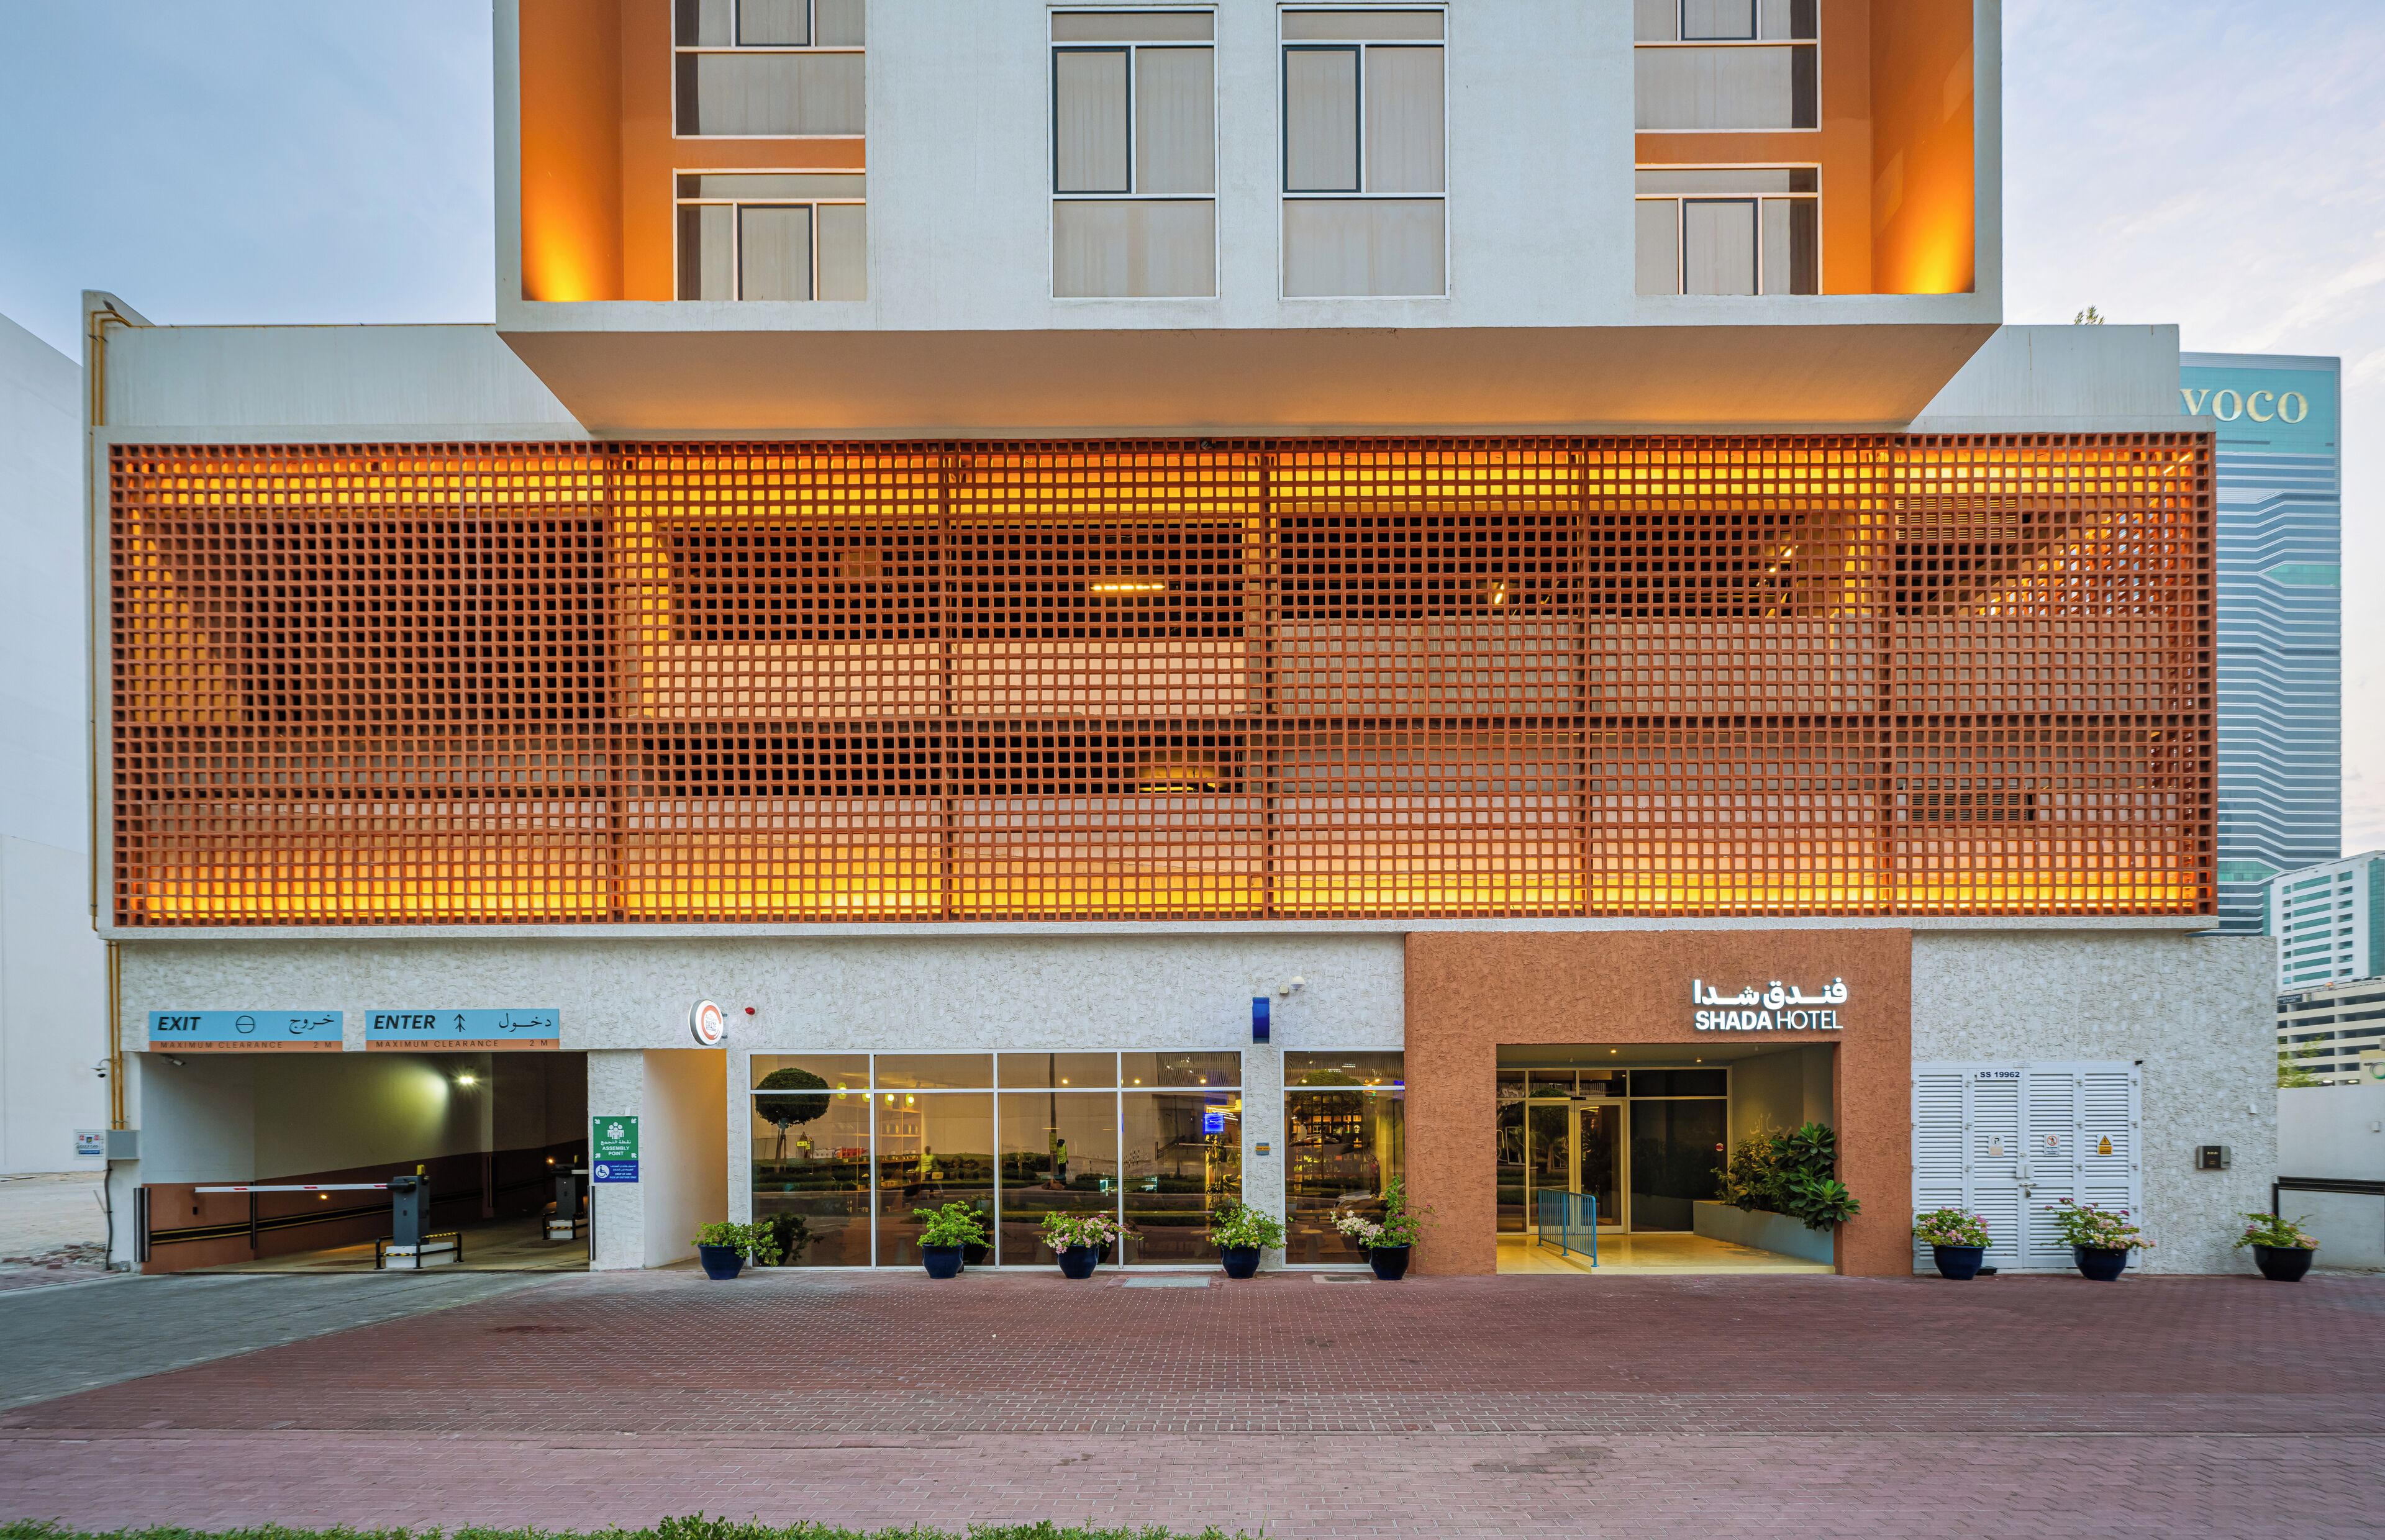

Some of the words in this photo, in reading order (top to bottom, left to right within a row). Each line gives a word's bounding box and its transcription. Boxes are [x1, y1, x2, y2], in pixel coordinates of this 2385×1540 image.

[1692, 979, 1760, 1005] شدا
[1761, 977, 1848, 1010] فندق
[157, 1016, 201, 1031] EXIT
[289, 1014, 334, 1035] خروج
[373, 1015, 435, 1030] ENTER
[499, 1013, 552, 1033] دخول
[1694, 1010, 1773, 1030] SHADA
[1775, 1010, 1843, 1030] HOTEL
[434, 1040, 499, 1048] CLEARANCE
